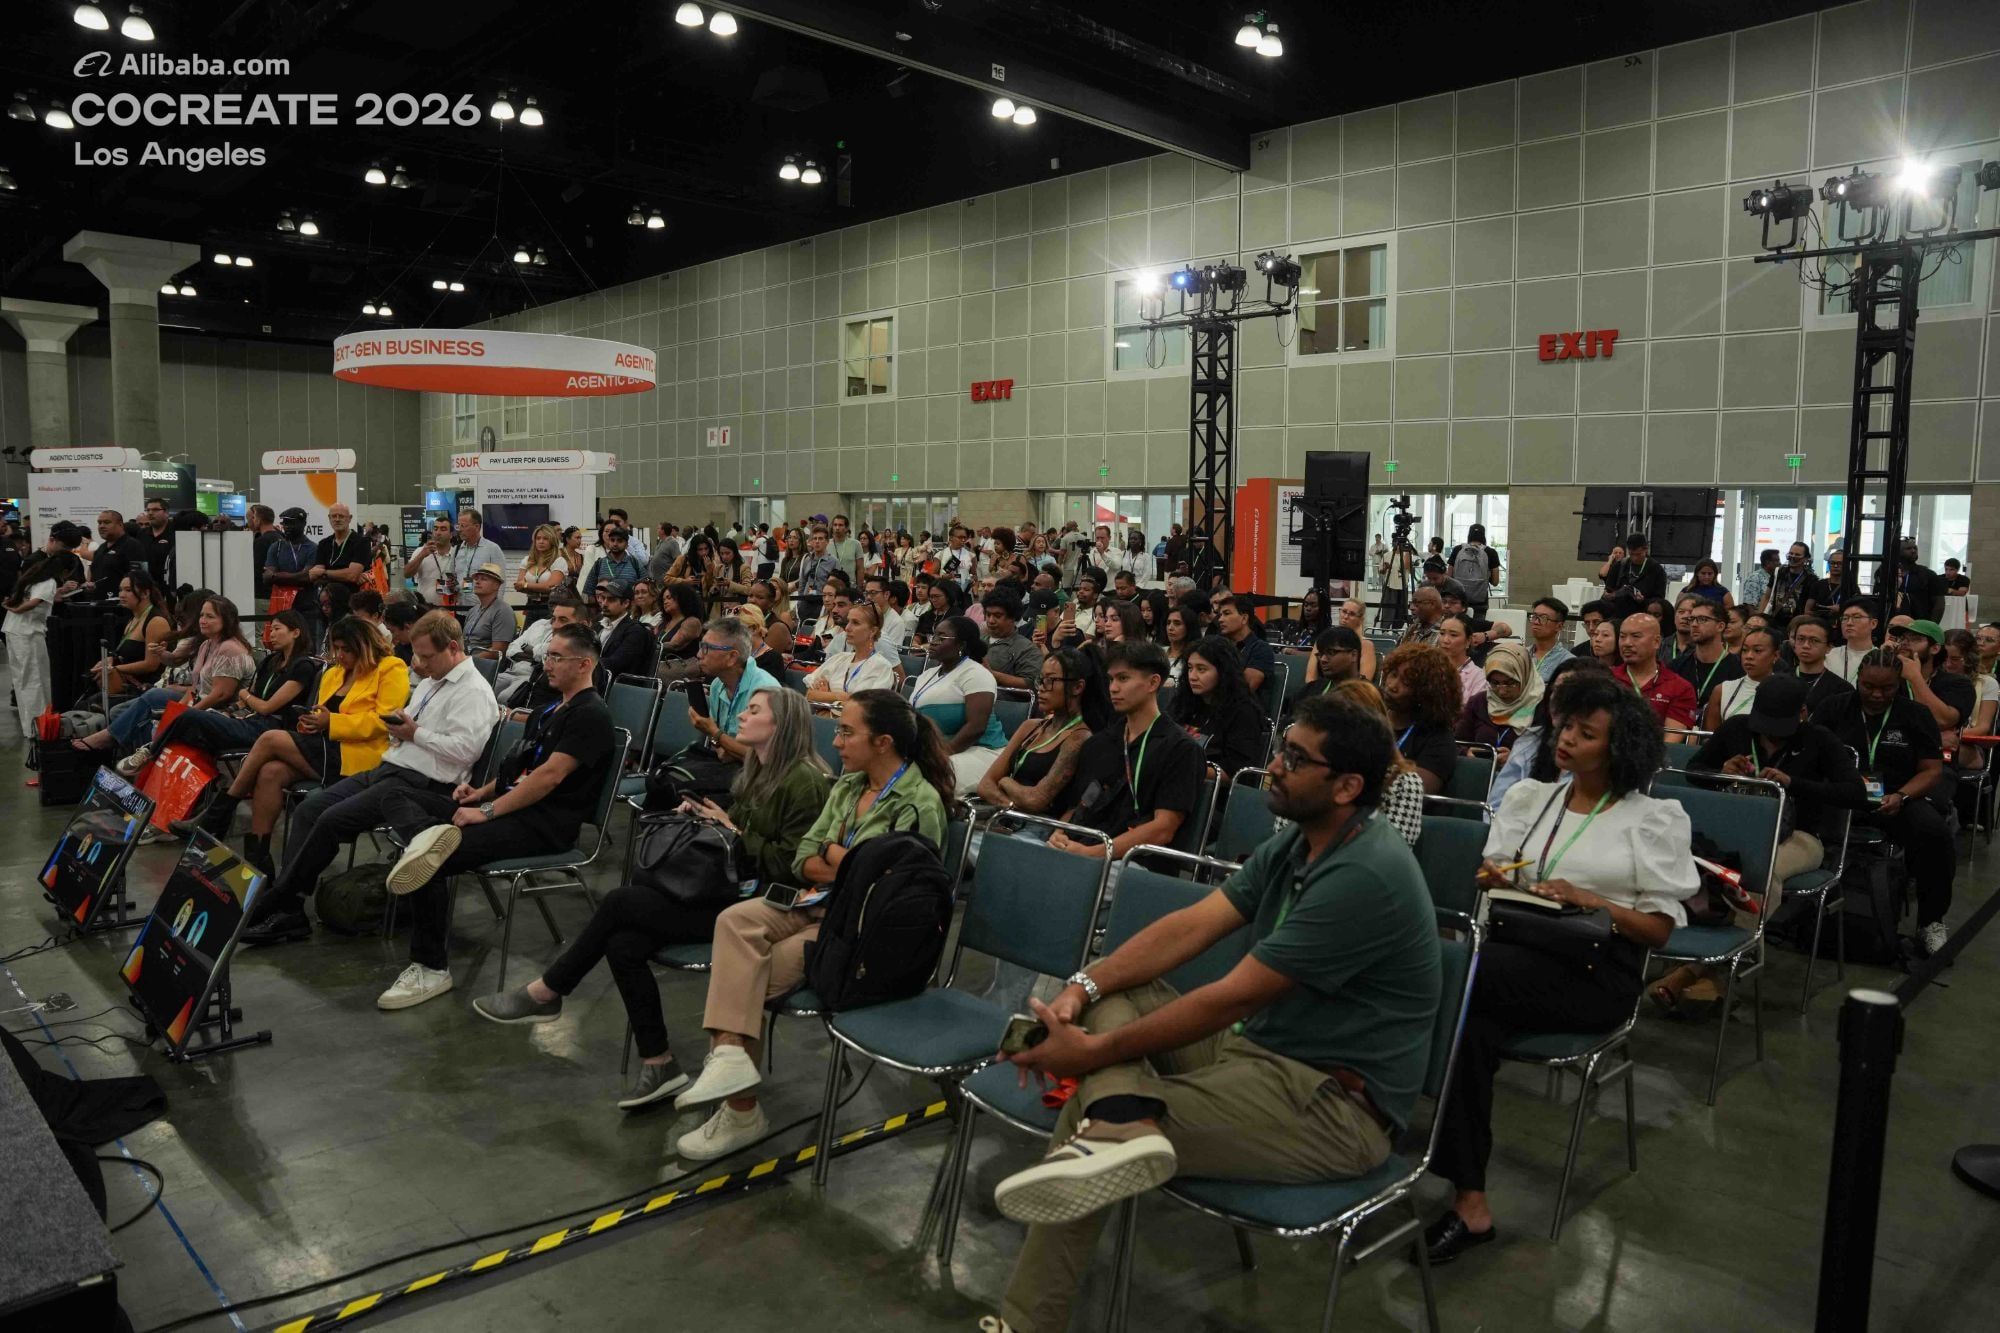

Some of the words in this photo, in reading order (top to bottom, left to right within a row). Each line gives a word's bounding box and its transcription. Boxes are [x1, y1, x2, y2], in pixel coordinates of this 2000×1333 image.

[993, 67, 1003, 78] 16
[386, 340, 485, 356] BUSINESS
[1539, 329, 1618, 361] EXIT
[566, 375, 625, 389] AGENTIC
[971, 379, 1013, 401] EXIT
[73, 453, 103, 461] LOGISTICS
[285, 456, 320, 464] Alibaba.com
[142, 470, 178, 481] BUSINESS
[169, 755, 200, 780] IT
